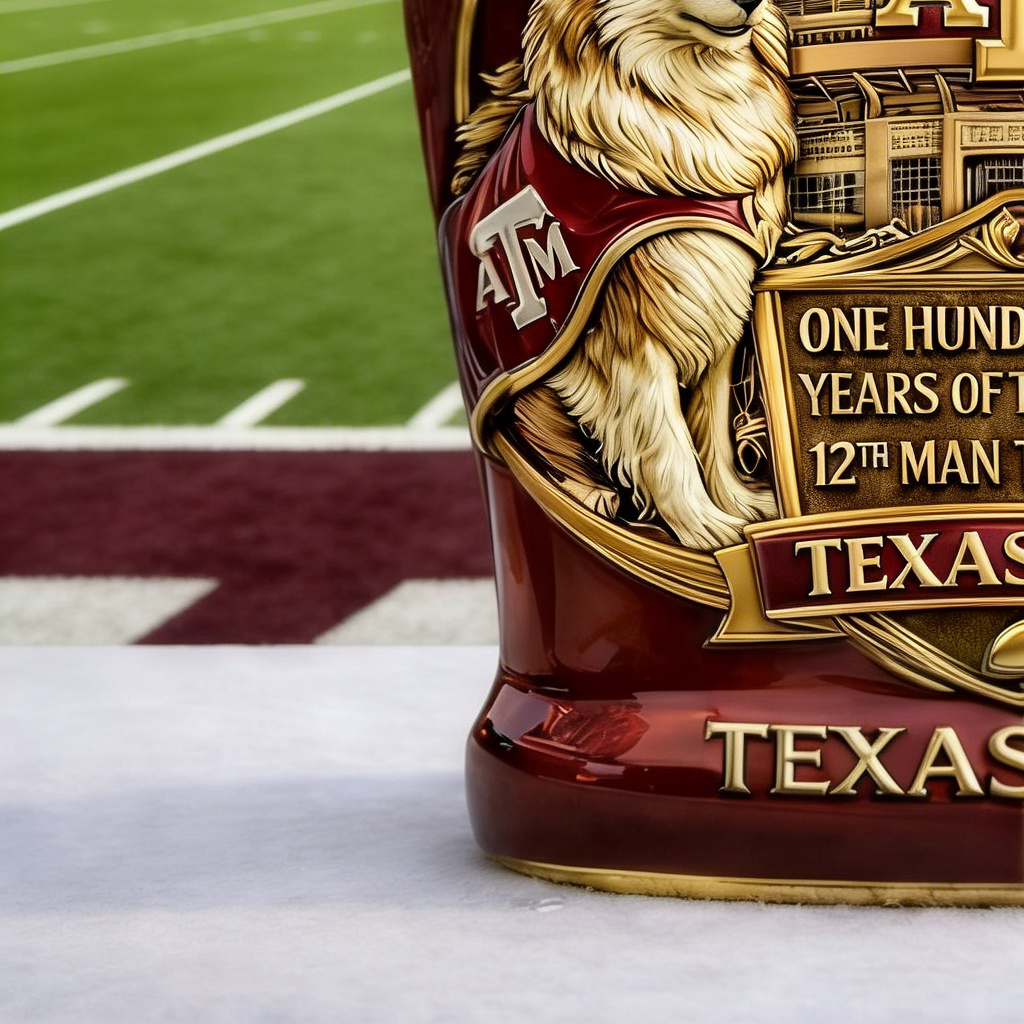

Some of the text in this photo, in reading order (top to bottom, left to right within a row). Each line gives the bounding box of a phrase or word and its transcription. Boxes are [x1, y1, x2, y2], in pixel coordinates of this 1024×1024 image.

[799, 306, 889, 354] ONE
[797, 371, 941, 417] YEARS
[950, 371, 1005, 416] OF
[808, 440, 890, 487] 12TH
[900, 439, 1001, 486] MAN
